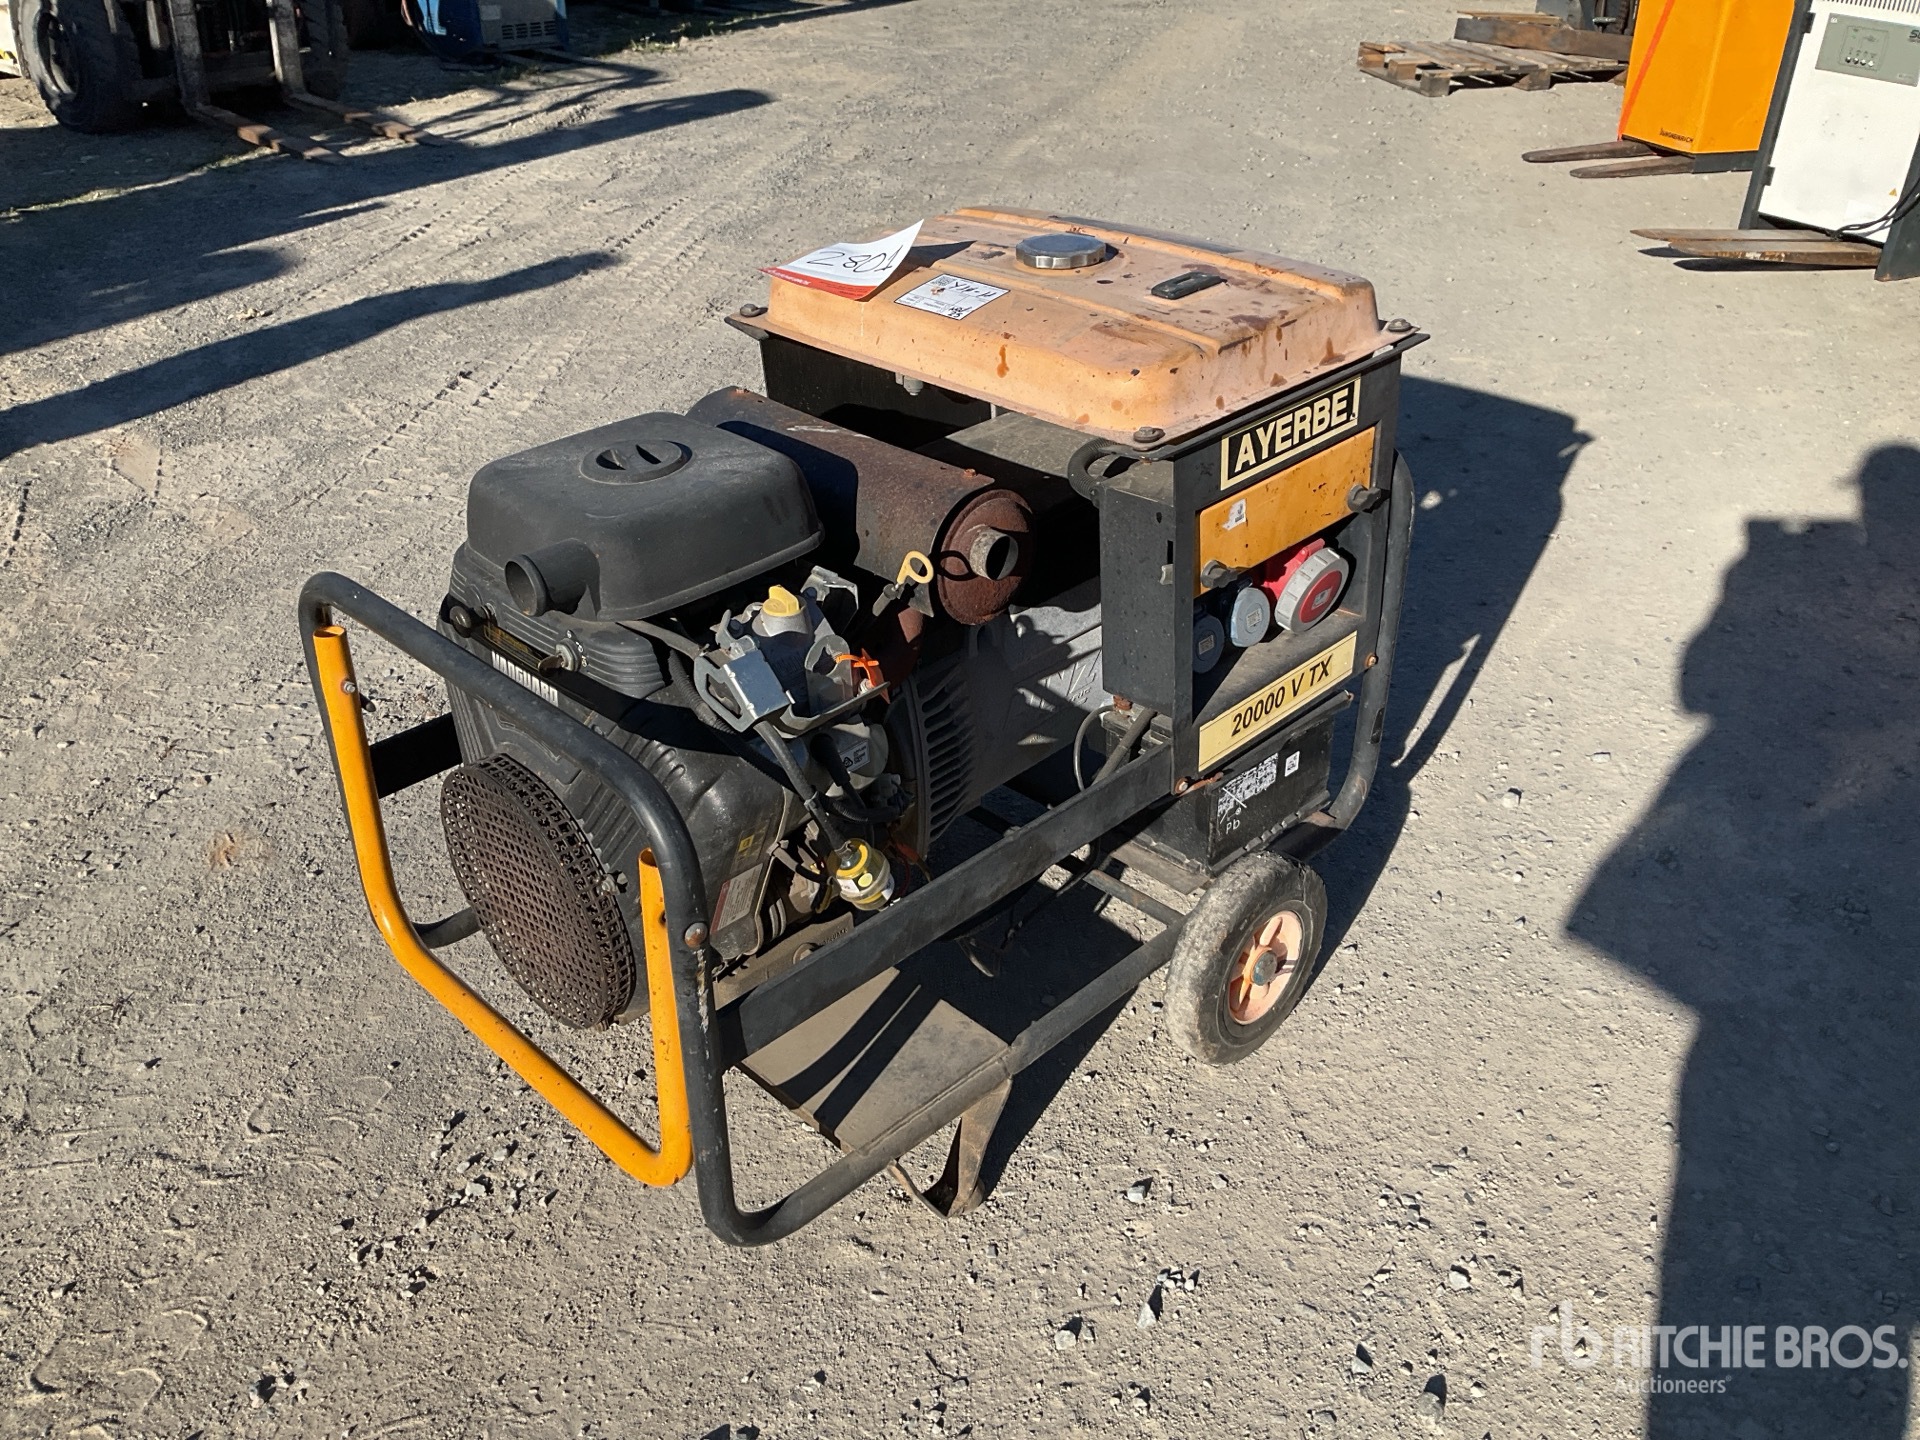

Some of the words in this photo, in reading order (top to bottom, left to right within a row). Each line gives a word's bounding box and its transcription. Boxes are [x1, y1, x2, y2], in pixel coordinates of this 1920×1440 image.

[806, 245, 903, 272] 2801
[1234, 388, 1348, 473] AYERBE
[491, 650, 559, 707] VANGUARD
[1231, 686, 1286, 737] 20000
[1291, 673, 1305, 698] V
[1309, 653, 1334, 688] TX
